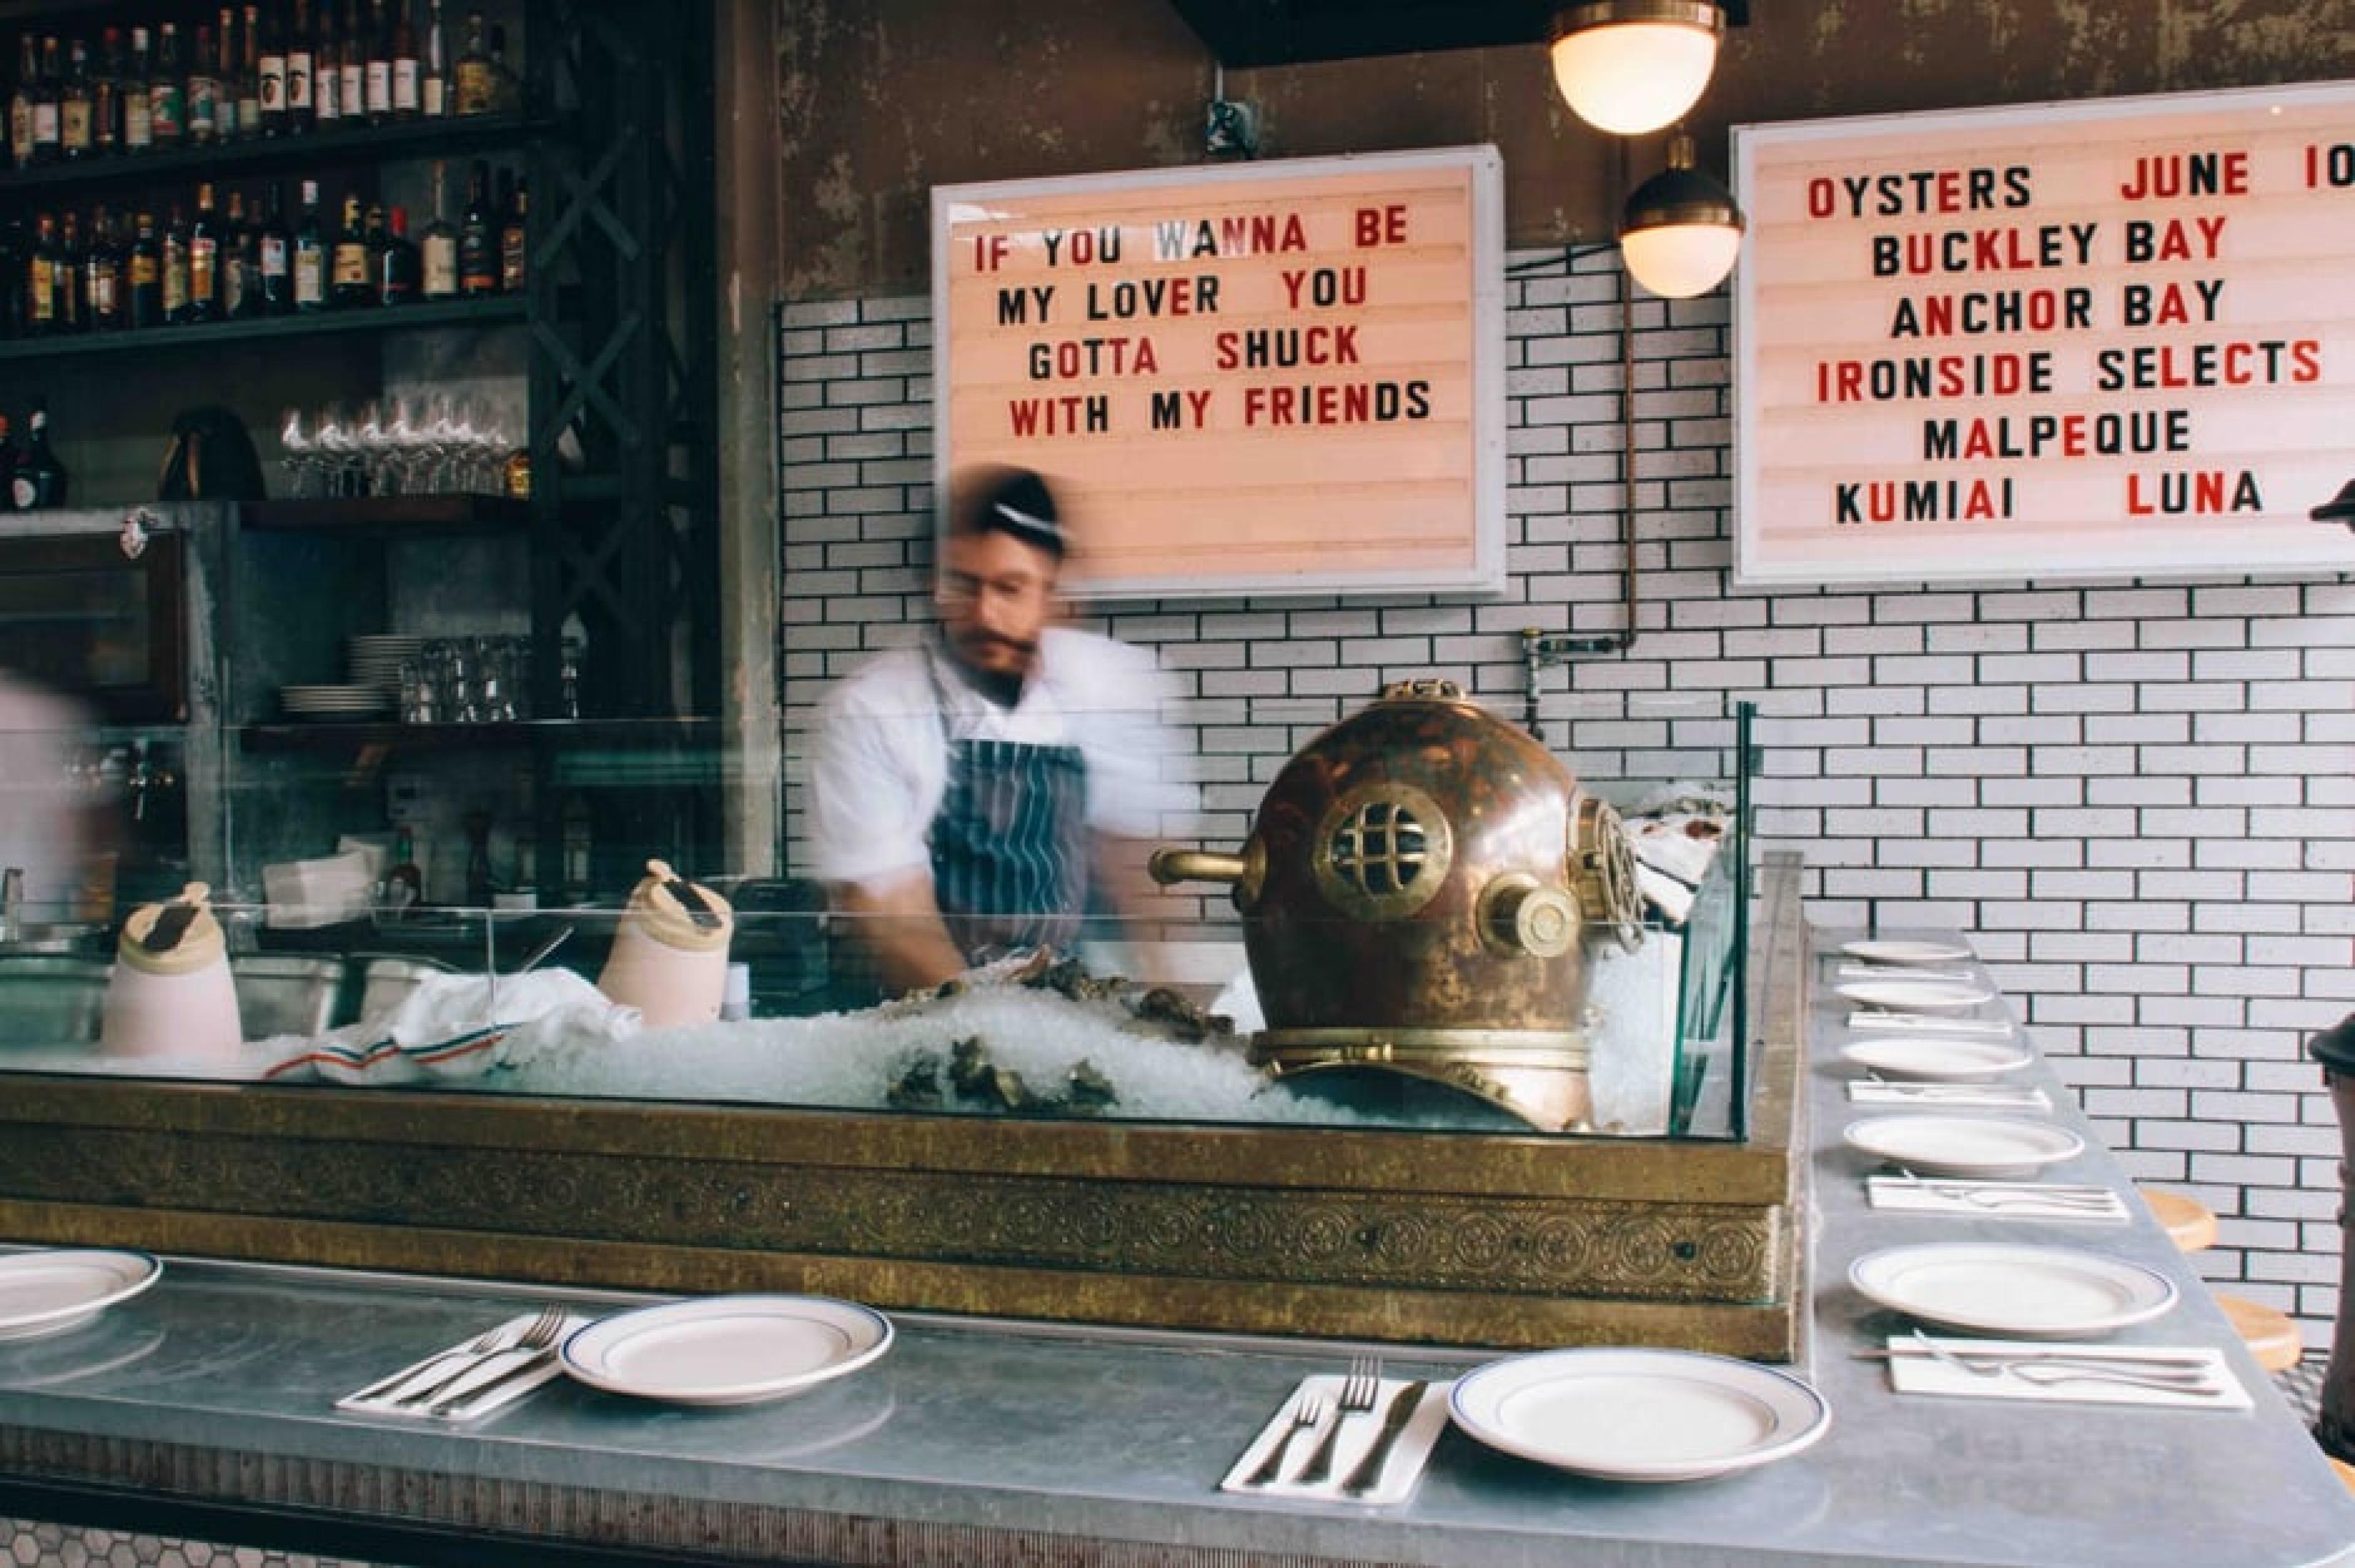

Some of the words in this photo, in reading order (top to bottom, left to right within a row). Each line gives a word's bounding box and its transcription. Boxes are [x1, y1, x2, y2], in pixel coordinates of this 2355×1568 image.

[1808, 166, 2031, 218] OYSTERS
[2122, 153, 2248, 202] JUNE
[975, 235, 1009, 272] IF
[1043, 226, 1121, 267] YOU
[1156, 213, 1306, 260] WANNA
[1355, 205, 1407, 248] BE
[1873, 223, 2097, 277] BUCKLEY
[2126, 217, 2226, 262] BAY
[998, 286, 1055, 325] MY
[1088, 275, 1219, 321] LOVER
[1282, 267, 1367, 309] YOU
[1891, 288, 2092, 338] ANCHOR
[2124, 280, 2224, 327] BAY
[1029, 337, 1157, 381] GOTTA
[1216, 326, 1358, 370] SHUCK
[1818, 352, 2053, 402] IRONSIDE
[2098, 340, 2321, 391] SELECTS
[1010, 395, 1108, 437] WITH
[1151, 390, 1212, 430] MY
[1244, 381, 1430, 426] FRIENDS
[1924, 410, 2190, 461] MALPEQUE
[1836, 477, 2012, 523] KUMIAI
[2127, 470, 2262, 514] LUNA
